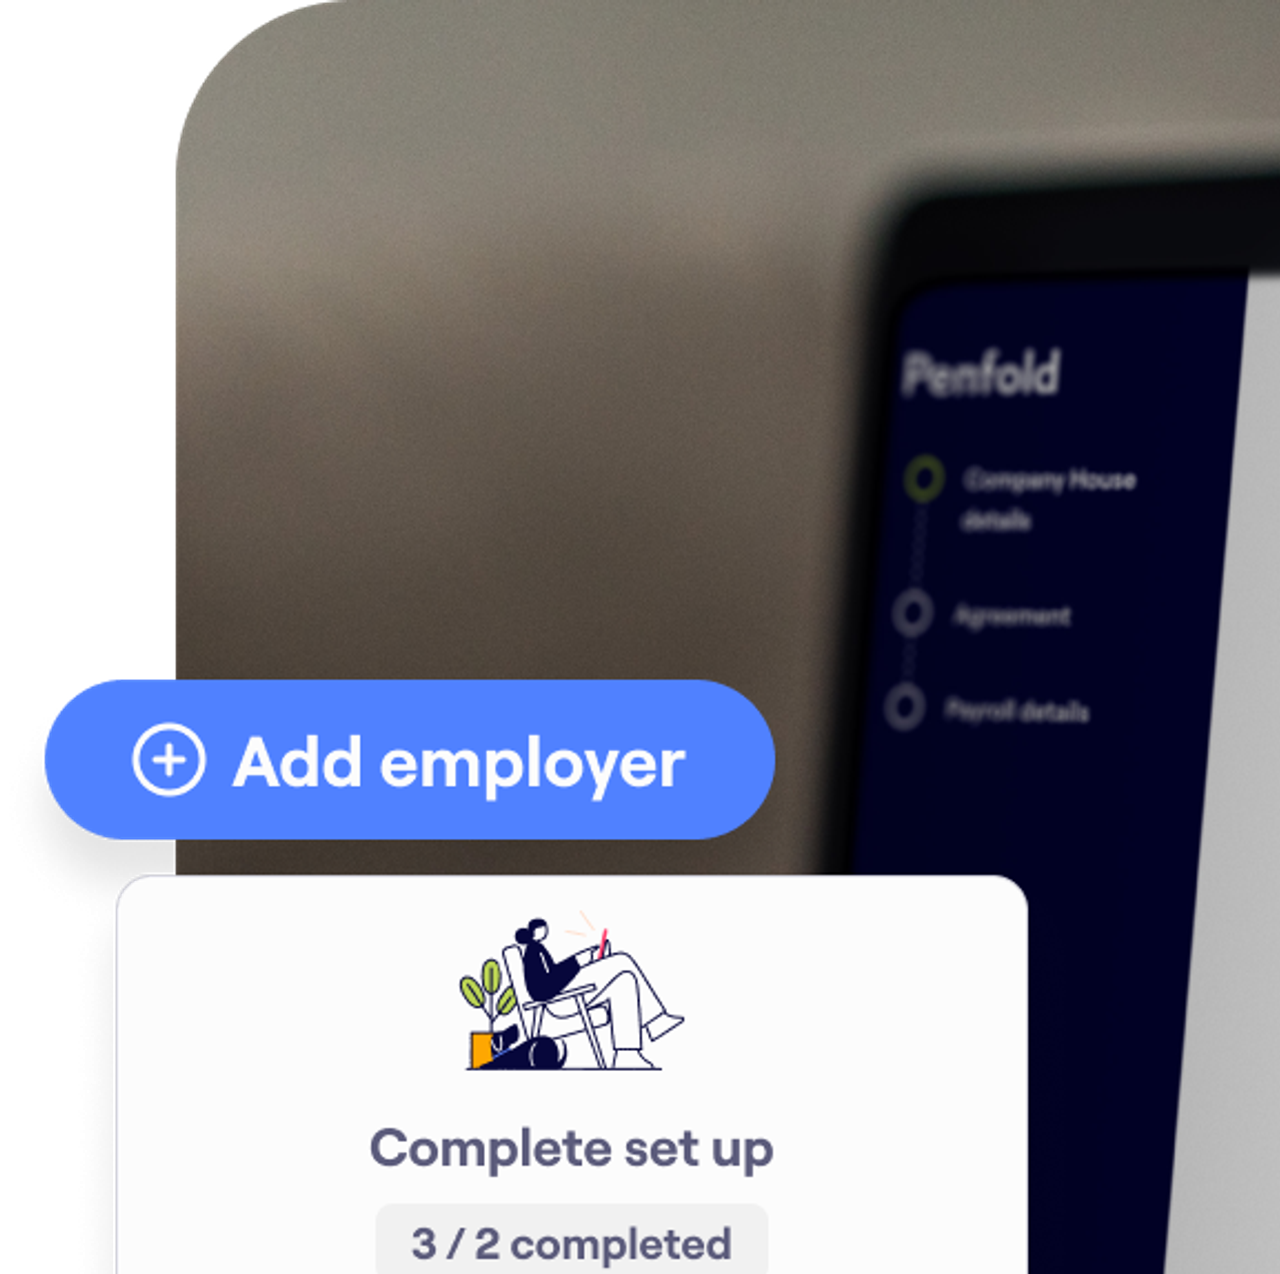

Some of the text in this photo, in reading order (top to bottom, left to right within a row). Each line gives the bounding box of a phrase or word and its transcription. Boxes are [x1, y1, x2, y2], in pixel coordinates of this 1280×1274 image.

[902, 347, 1062, 397] Penfold
[964, 467, 1138, 495] Company House
[961, 507, 1032, 532] details
[953, 604, 1072, 632] Agreement
[943, 696, 1091, 726] Payroll details
